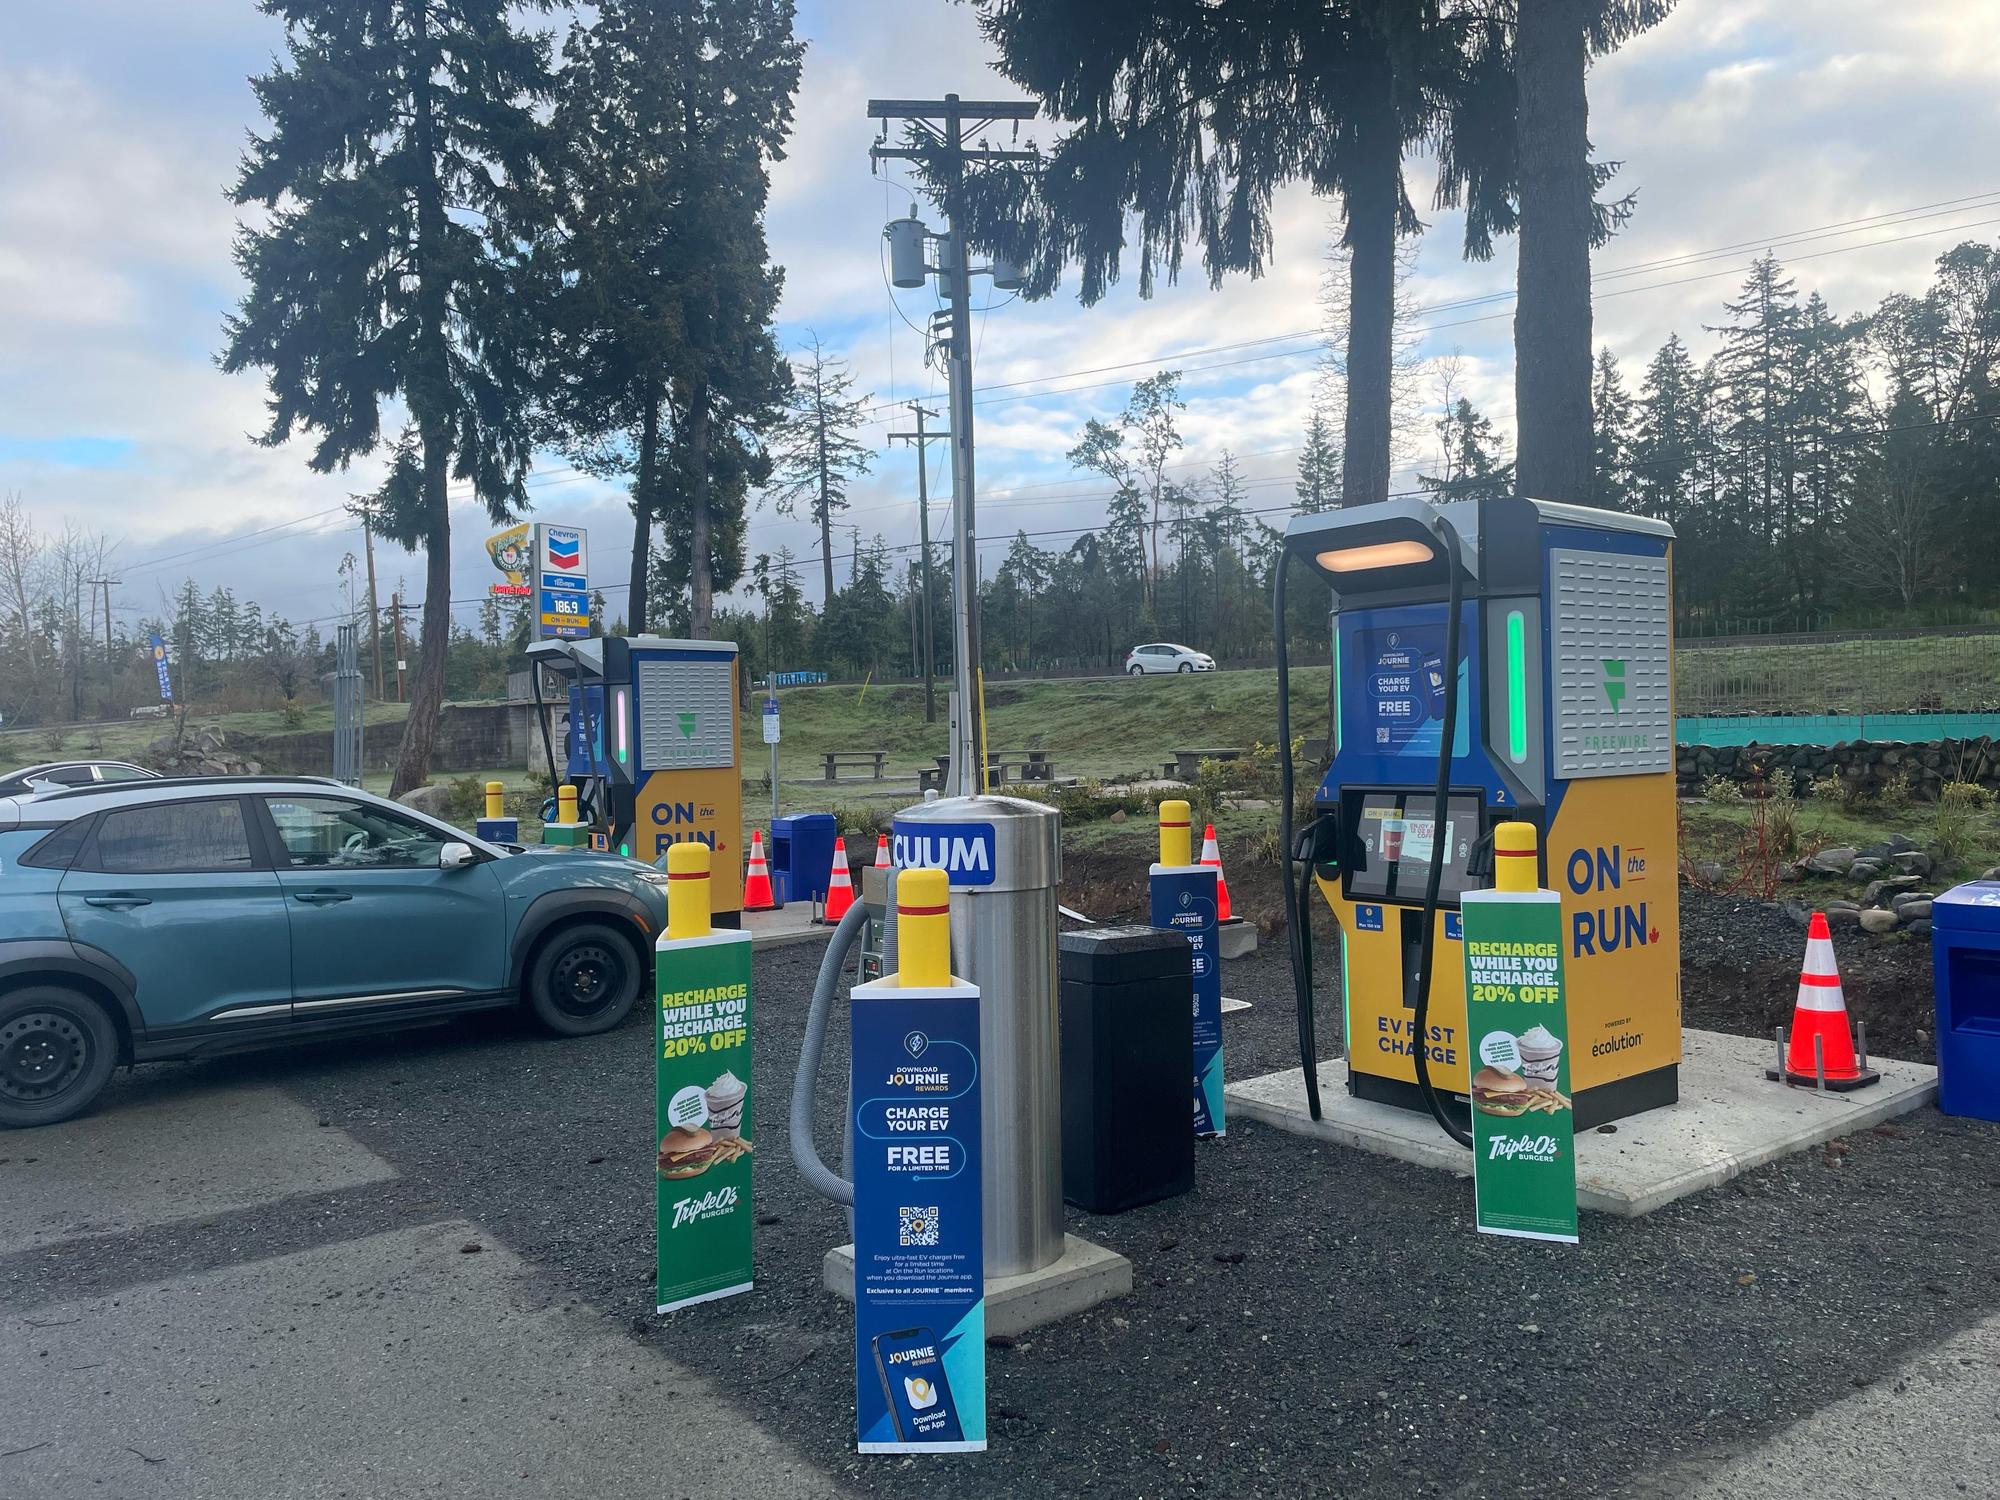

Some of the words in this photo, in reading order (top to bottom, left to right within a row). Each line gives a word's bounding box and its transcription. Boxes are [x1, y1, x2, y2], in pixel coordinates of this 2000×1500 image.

[549, 528, 578, 539] Chevron
[554, 600, 578, 614] 186.9
[1378, 656, 1410, 665] JOURNIE
[1377, 677, 1410, 686] CHARGE
[1378, 685, 1399, 693] YOUR
[1378, 701, 1410, 713] FREE
[1584, 734, 1648, 750] FREEWIRE
[1322, 786, 1328, 798] 1
[1496, 790, 1505, 803] 2
[651, 802, 694, 826] ON
[699, 806, 715, 817] the
[893, 834, 989, 871] CUUM
[1567, 845, 1620, 895] ON
[1627, 856, 1646, 873] the
[1170, 916, 1203, 925] JOURNIE
[1572, 902, 1647, 959] RUN
[1187, 935, 1203, 943] RGE
[1468, 942, 1558, 957] RECHARGE
[1469, 956, 1521, 970] WHILE
[1523, 957, 1558, 971] YOU
[1471, 970, 1559, 986] RECHARGE.
[662, 983, 747, 1009] RECHARGE
[1472, 985, 1516, 1002] 20%
[1519, 986, 1559, 1004] OFF
[663, 1003, 714, 1024] WHILE
[715, 998, 747, 1016] YOU
[663, 1014, 747, 1040] RECHARGE.
[1378, 1016, 1402, 1034] EV
[1604, 1019, 1625, 1029] POWERED
[663, 1036, 707, 1059] 20%
[710, 1029, 747, 1051] OFF
[886, 1073, 949, 1086] JOURNIE
[885, 1107, 949, 1119] CHARGE
[886, 1120, 926, 1131] YOUR
[930, 1120, 949, 1131] EV
[887, 1146, 950, 1165] FREE
[1518, 1153, 1554, 1162] BURGERS
[701, 1206, 734, 1220] BURGERS
[888, 1346, 935, 1364] JOURNIE
[911, 1357, 937, 1367] REWARDS
[912, 1409, 946, 1425] Download
[918, 1423, 930, 1433] the
[931, 1420, 946, 1431] App
